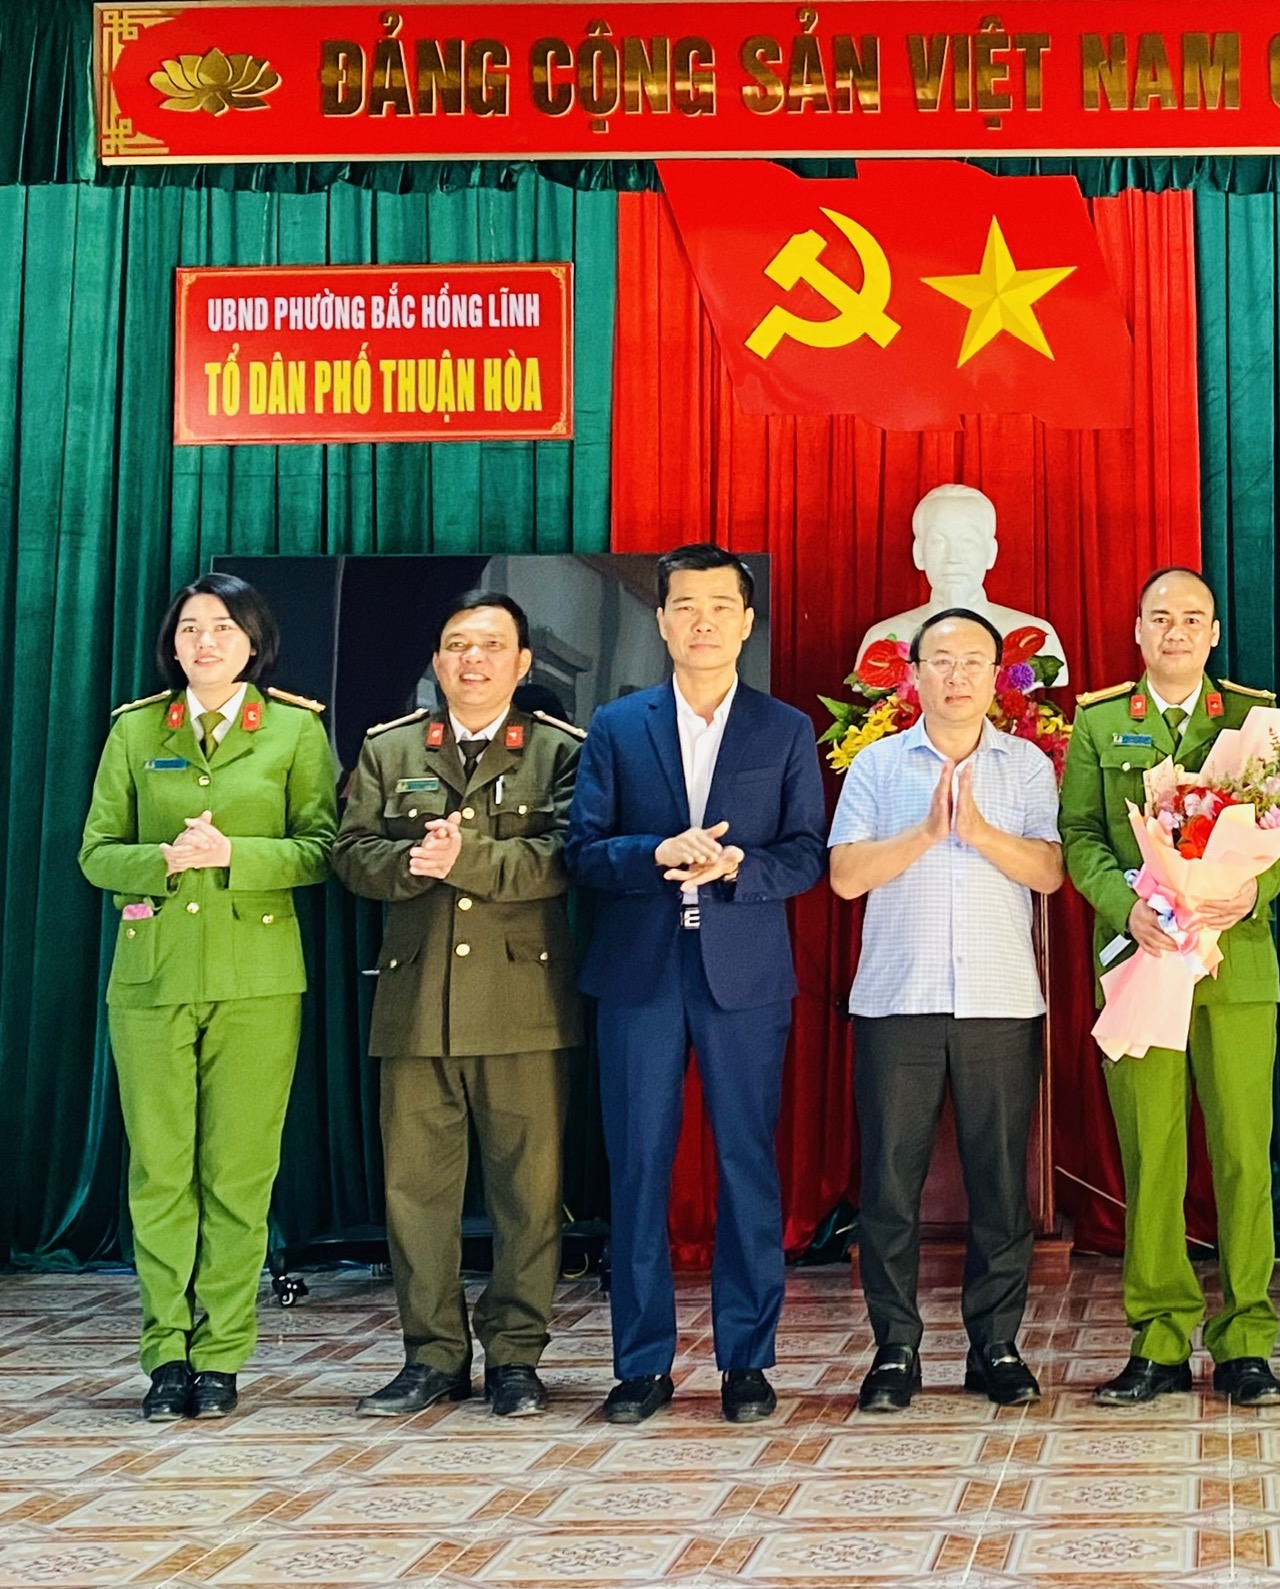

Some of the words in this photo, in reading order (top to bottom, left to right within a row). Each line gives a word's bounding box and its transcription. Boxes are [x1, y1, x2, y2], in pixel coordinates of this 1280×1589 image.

[319, 10, 510, 118] ĐẢNG
[530, 18, 717, 133] CỘNG
[739, 7, 881, 115] SẢN
[906, 14, 1051, 130] VIỆT
[1080, 30, 1241, 111] NAM
[207, 297, 269, 332] UBND
[274, 287, 366, 331] PHƯỜNG
[371, 281, 416, 329] BẮC
[421, 282, 483, 328] HỒNG
[488, 287, 540, 328] LĨNH
[204, 342, 241, 417] TỔ
[249, 351, 306, 415] DÂN
[314, 341, 372, 415] PHỐ
[379, 348, 476, 423] THUẬN
[483, 348, 543, 413] HÒA
